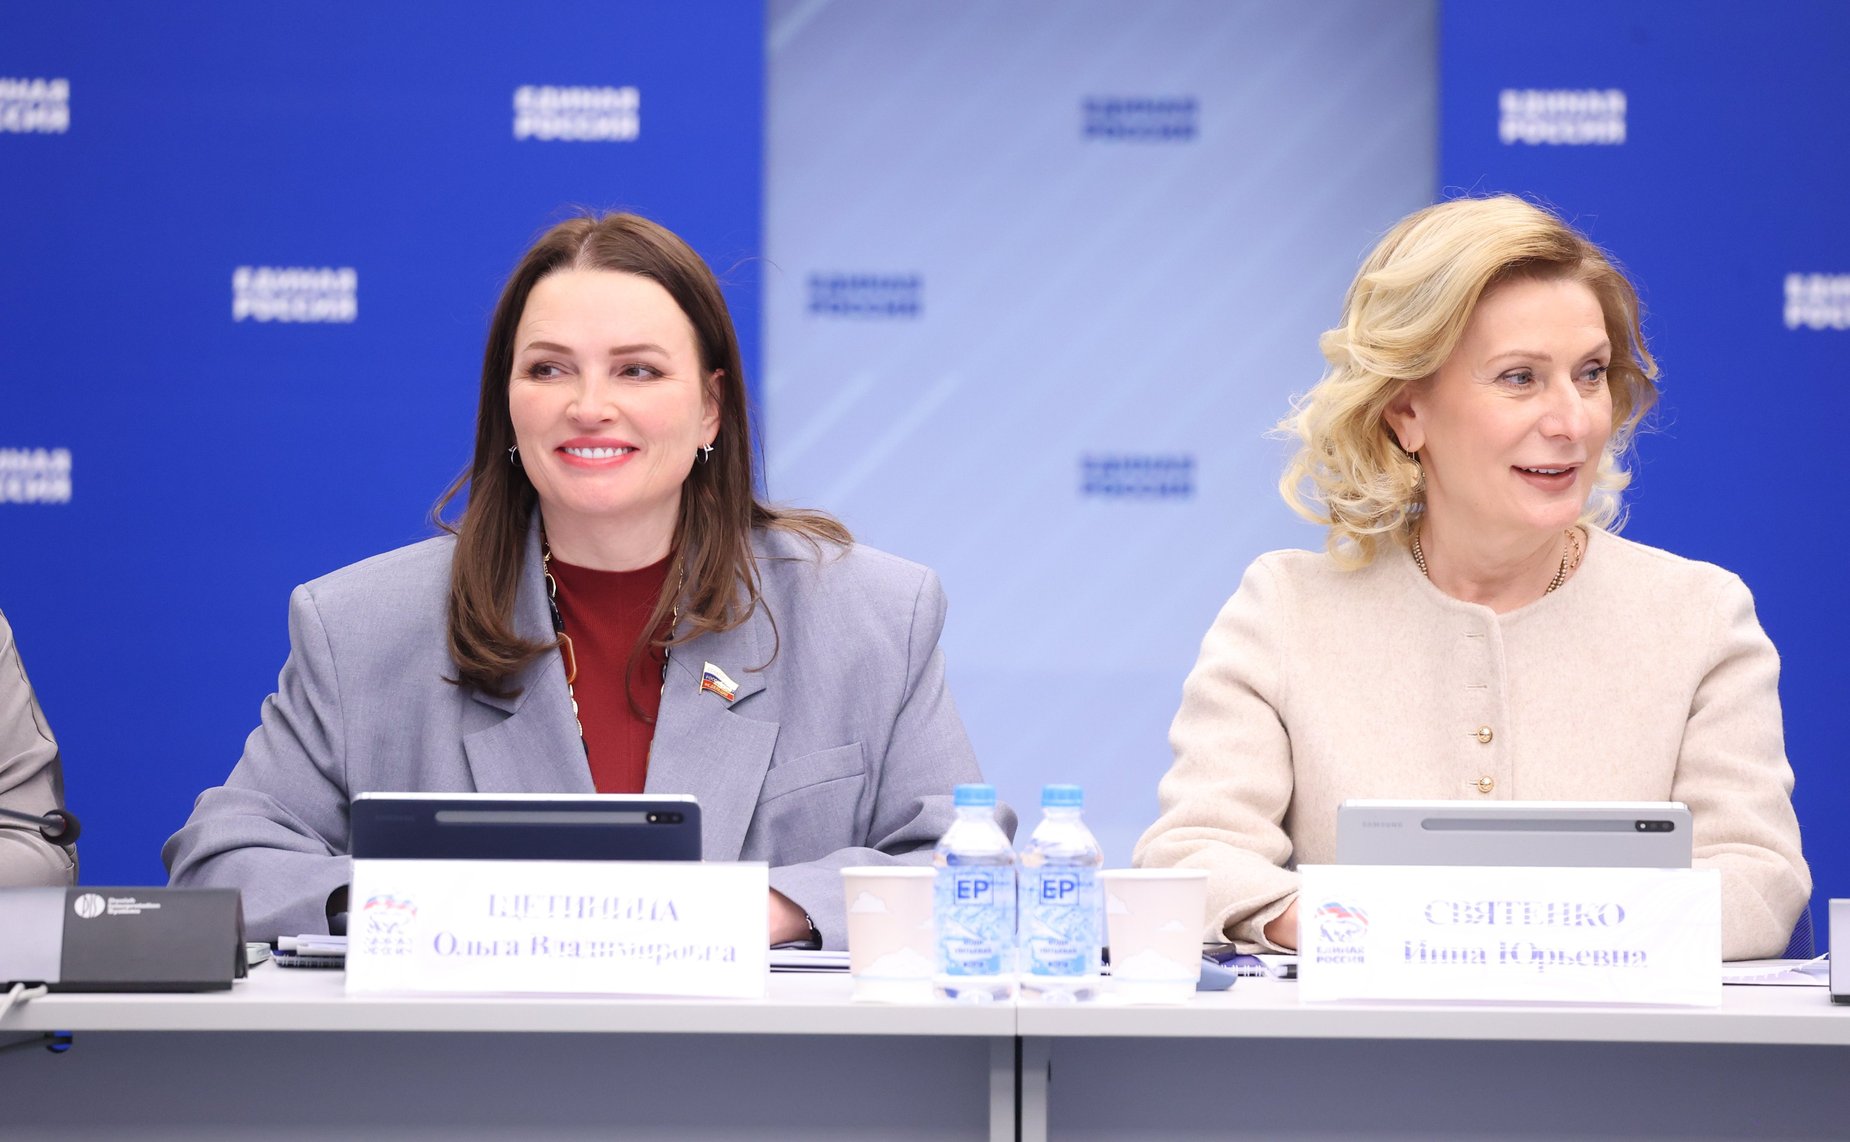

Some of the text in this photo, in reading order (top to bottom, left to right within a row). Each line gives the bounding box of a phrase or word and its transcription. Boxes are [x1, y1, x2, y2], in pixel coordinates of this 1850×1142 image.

[514, 85, 639, 113] ЕДИНАЯ
[1500, 89, 1626, 116] ЕДИНАЯ
[514, 114, 639, 141] РОССИЯ
[1500, 117, 1626, 145] РОССИЯ
[233, 266, 357, 293] ЕДИНАЯ
[233, 294, 357, 322] РОССИЯ
[957, 880, 988, 898] ЕР
[1043, 880, 1074, 898] ЕР
[1424, 901, 1625, 926] СВЯТЕНКО
[433, 932, 519, 957] Ольга
[1404, 940, 1648, 973] Инна Юрьевна
